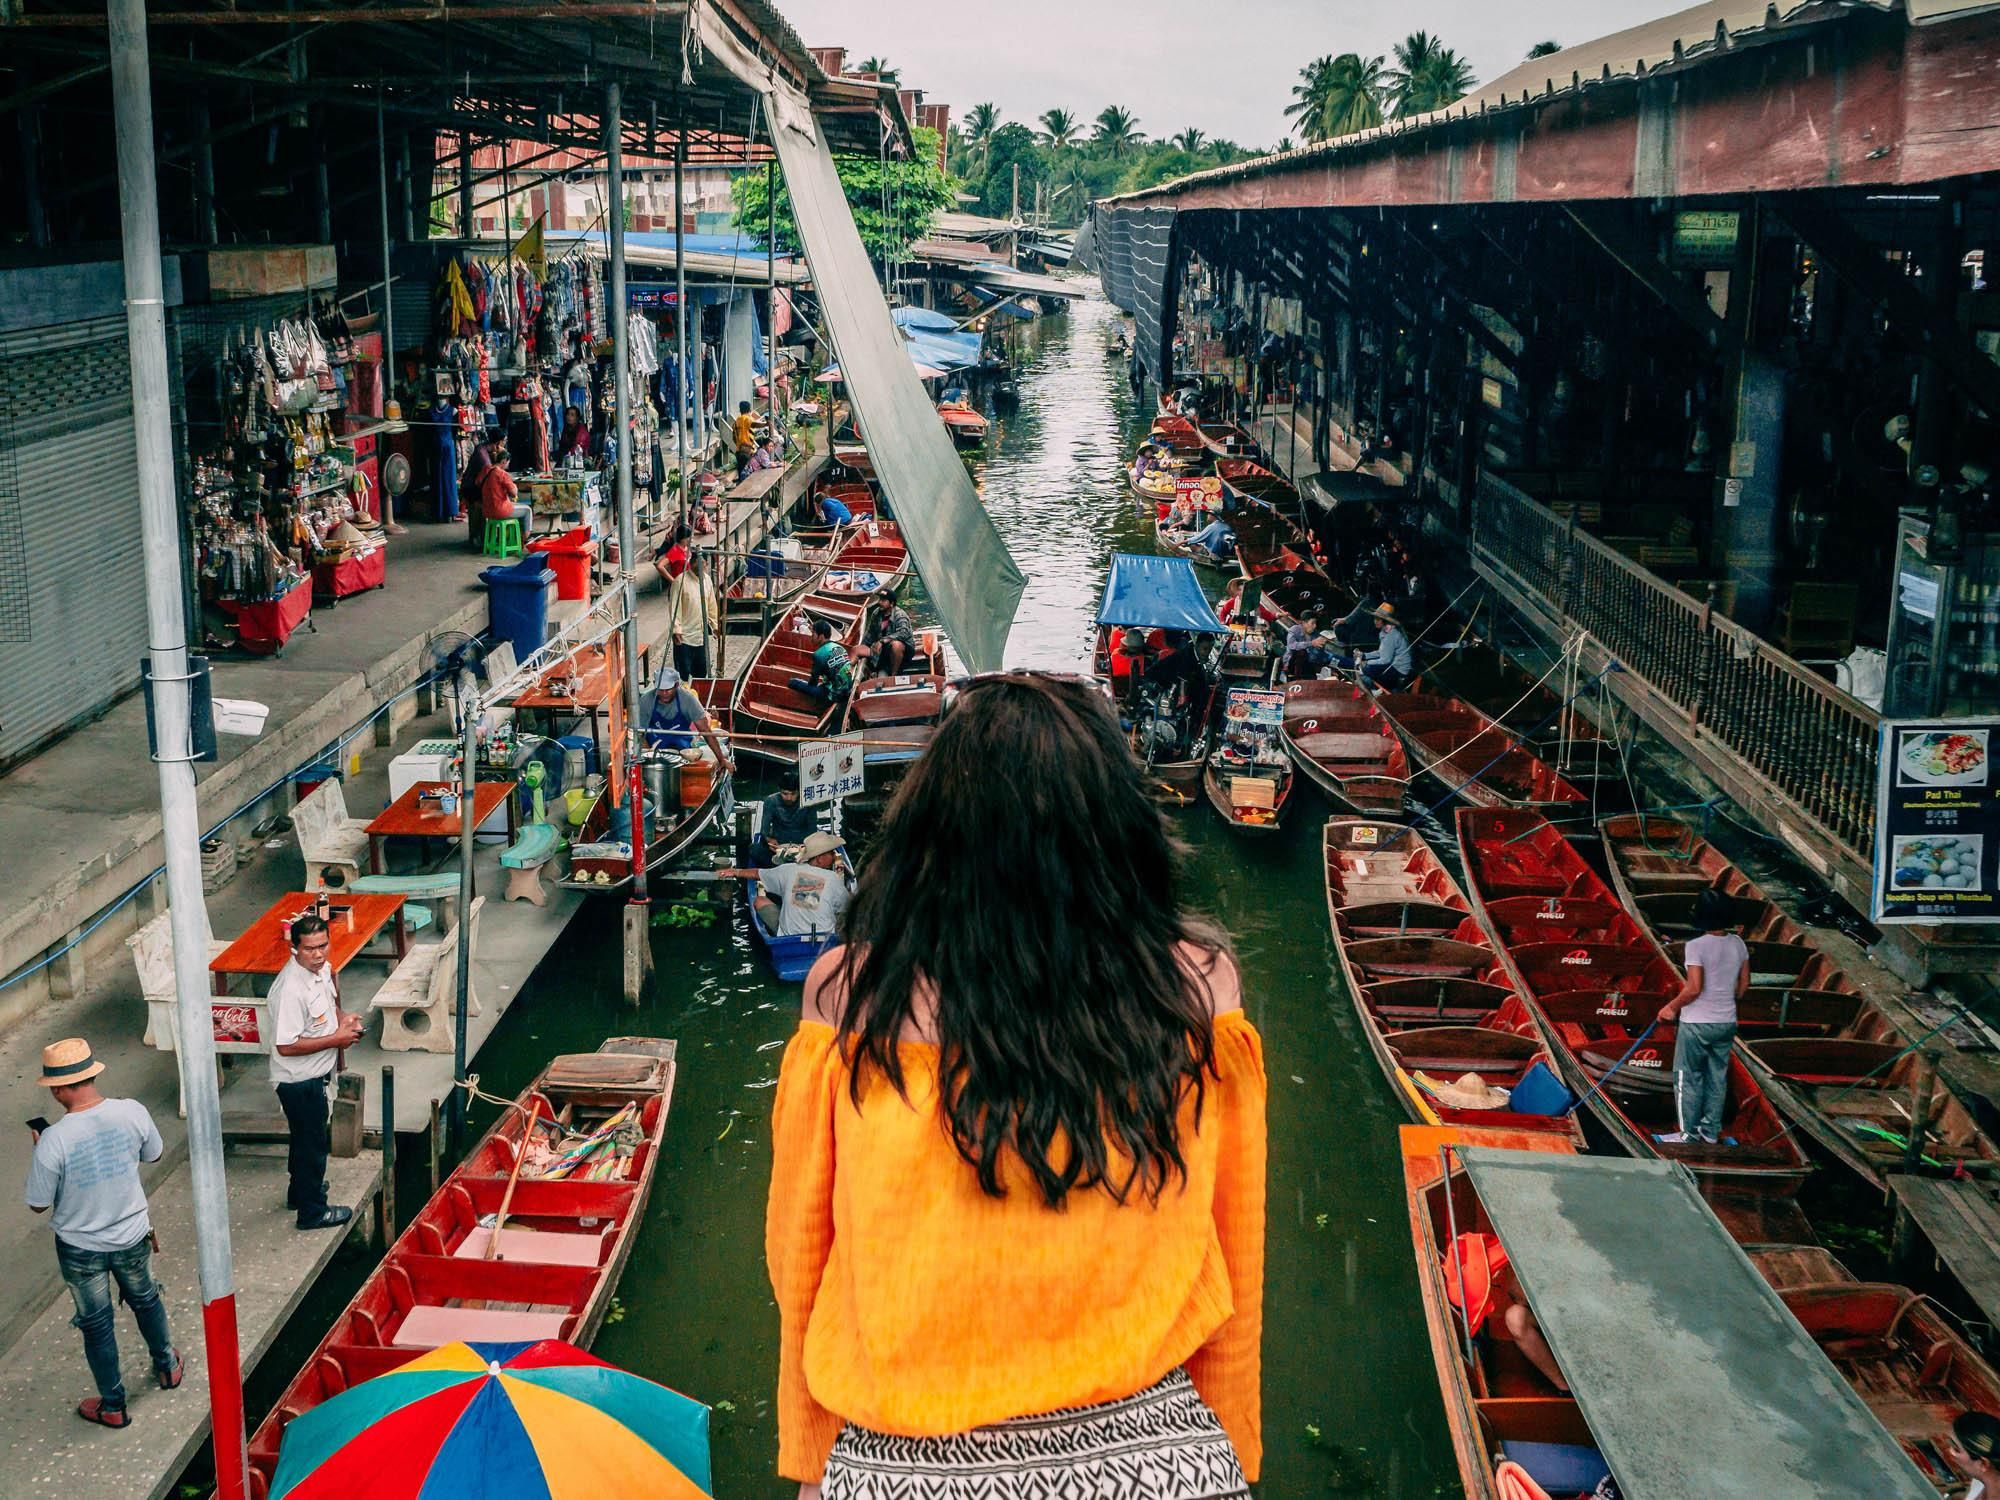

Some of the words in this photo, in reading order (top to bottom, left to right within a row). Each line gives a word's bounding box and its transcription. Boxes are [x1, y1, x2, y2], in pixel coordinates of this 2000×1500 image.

[803, 775, 863, 802] 椰子冰淇淋
[1925, 790, 1942, 799] Pad
[1944, 790, 1962, 799] Thai
[1493, 821, 1505, 833] 5
[212, 1007, 250, 1022] ca-Cola
